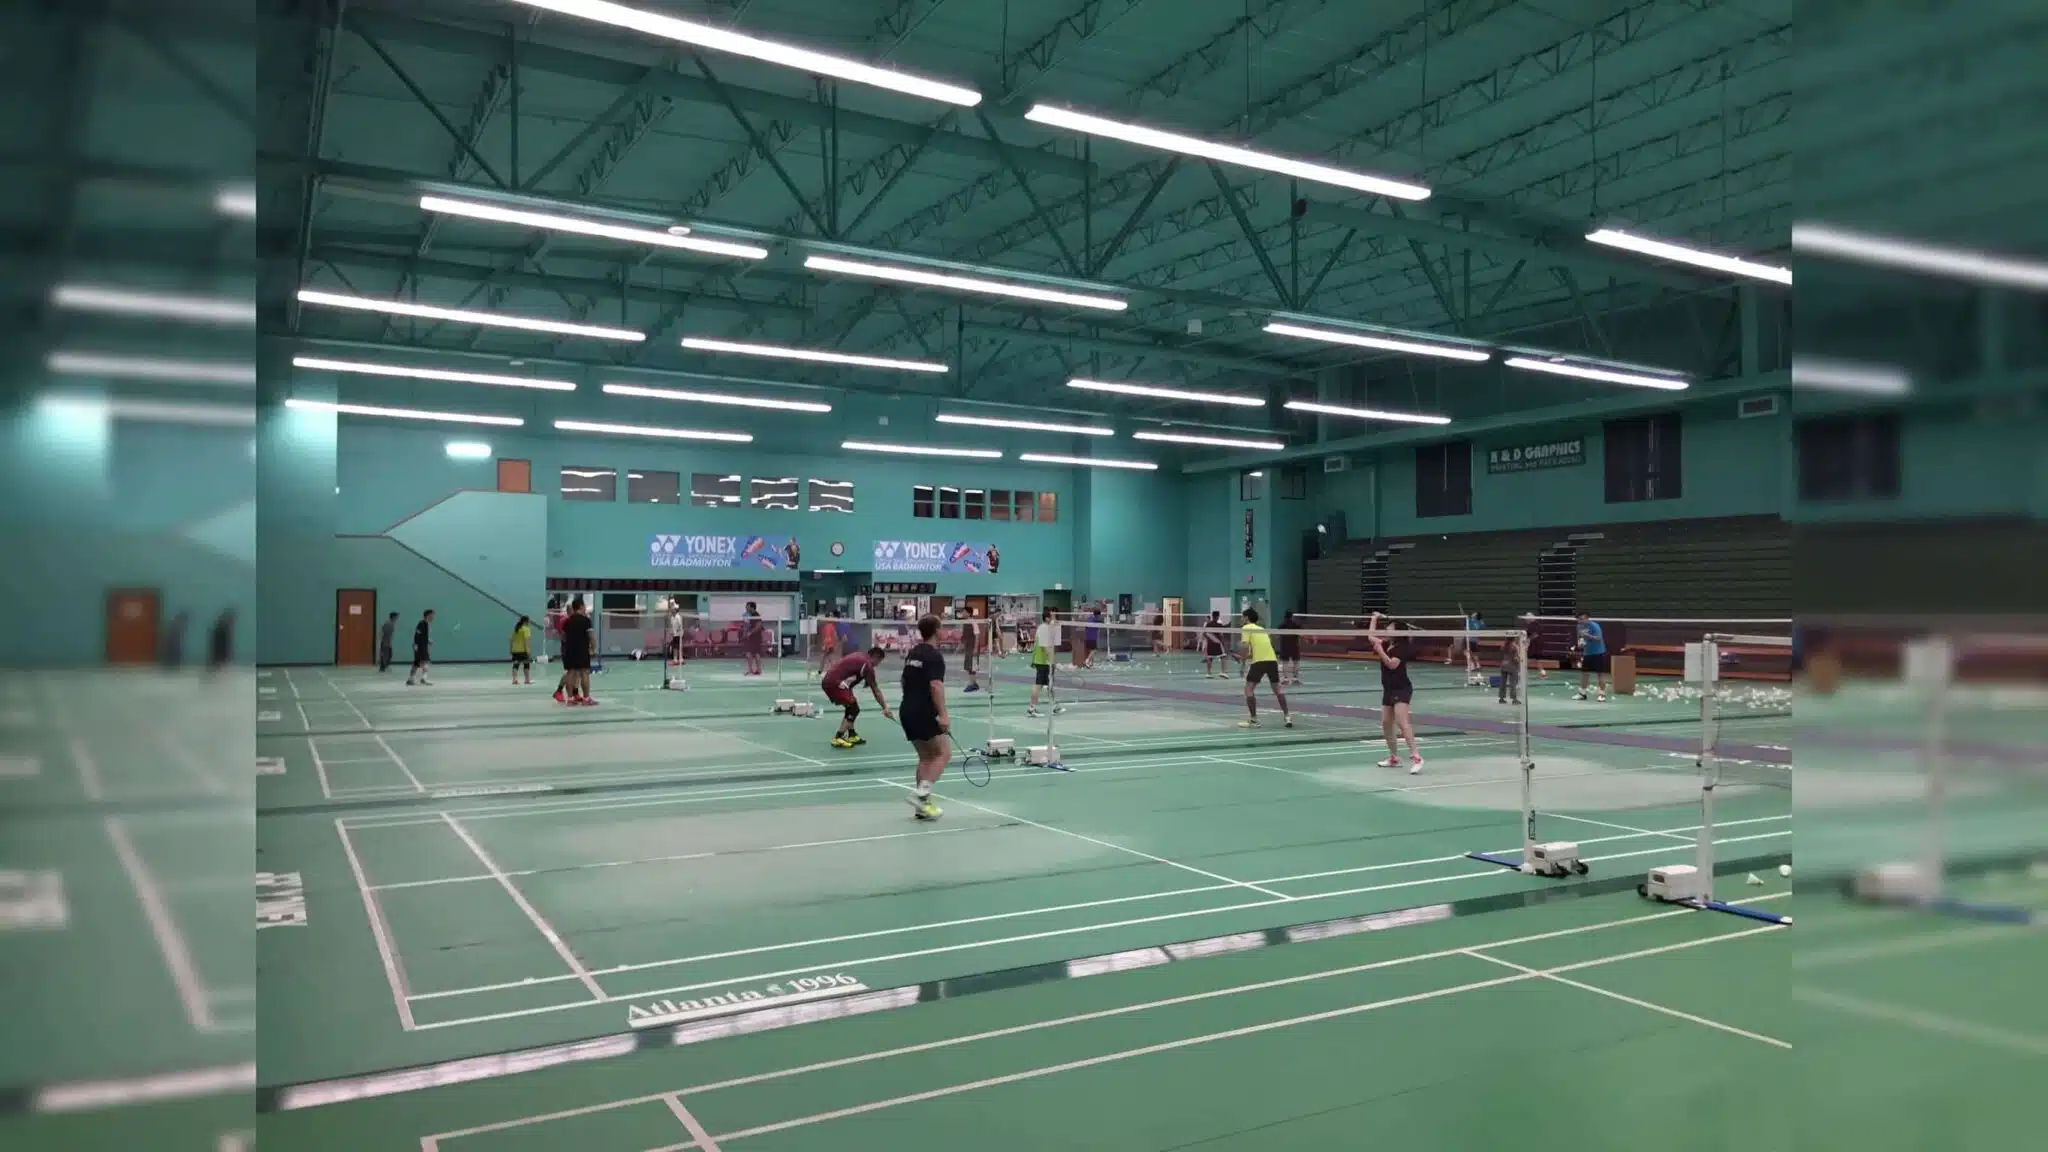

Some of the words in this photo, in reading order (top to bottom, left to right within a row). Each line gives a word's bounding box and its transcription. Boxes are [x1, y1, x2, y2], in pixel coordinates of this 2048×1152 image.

[1513, 448, 1521, 460] D
[1525, 440, 1580, 459] GRAPHICS
[684, 535, 737, 553] YONEX
[903, 542, 946, 559] YONEX
[651, 558, 671, 567] USA
[672, 558, 731, 568] BADMINTON
[875, 562, 892, 571] USA
[893, 562, 942, 572] BADMINTON
[628, 989, 767, 1020] Atlanta
[786, 972, 858, 994] 1996
